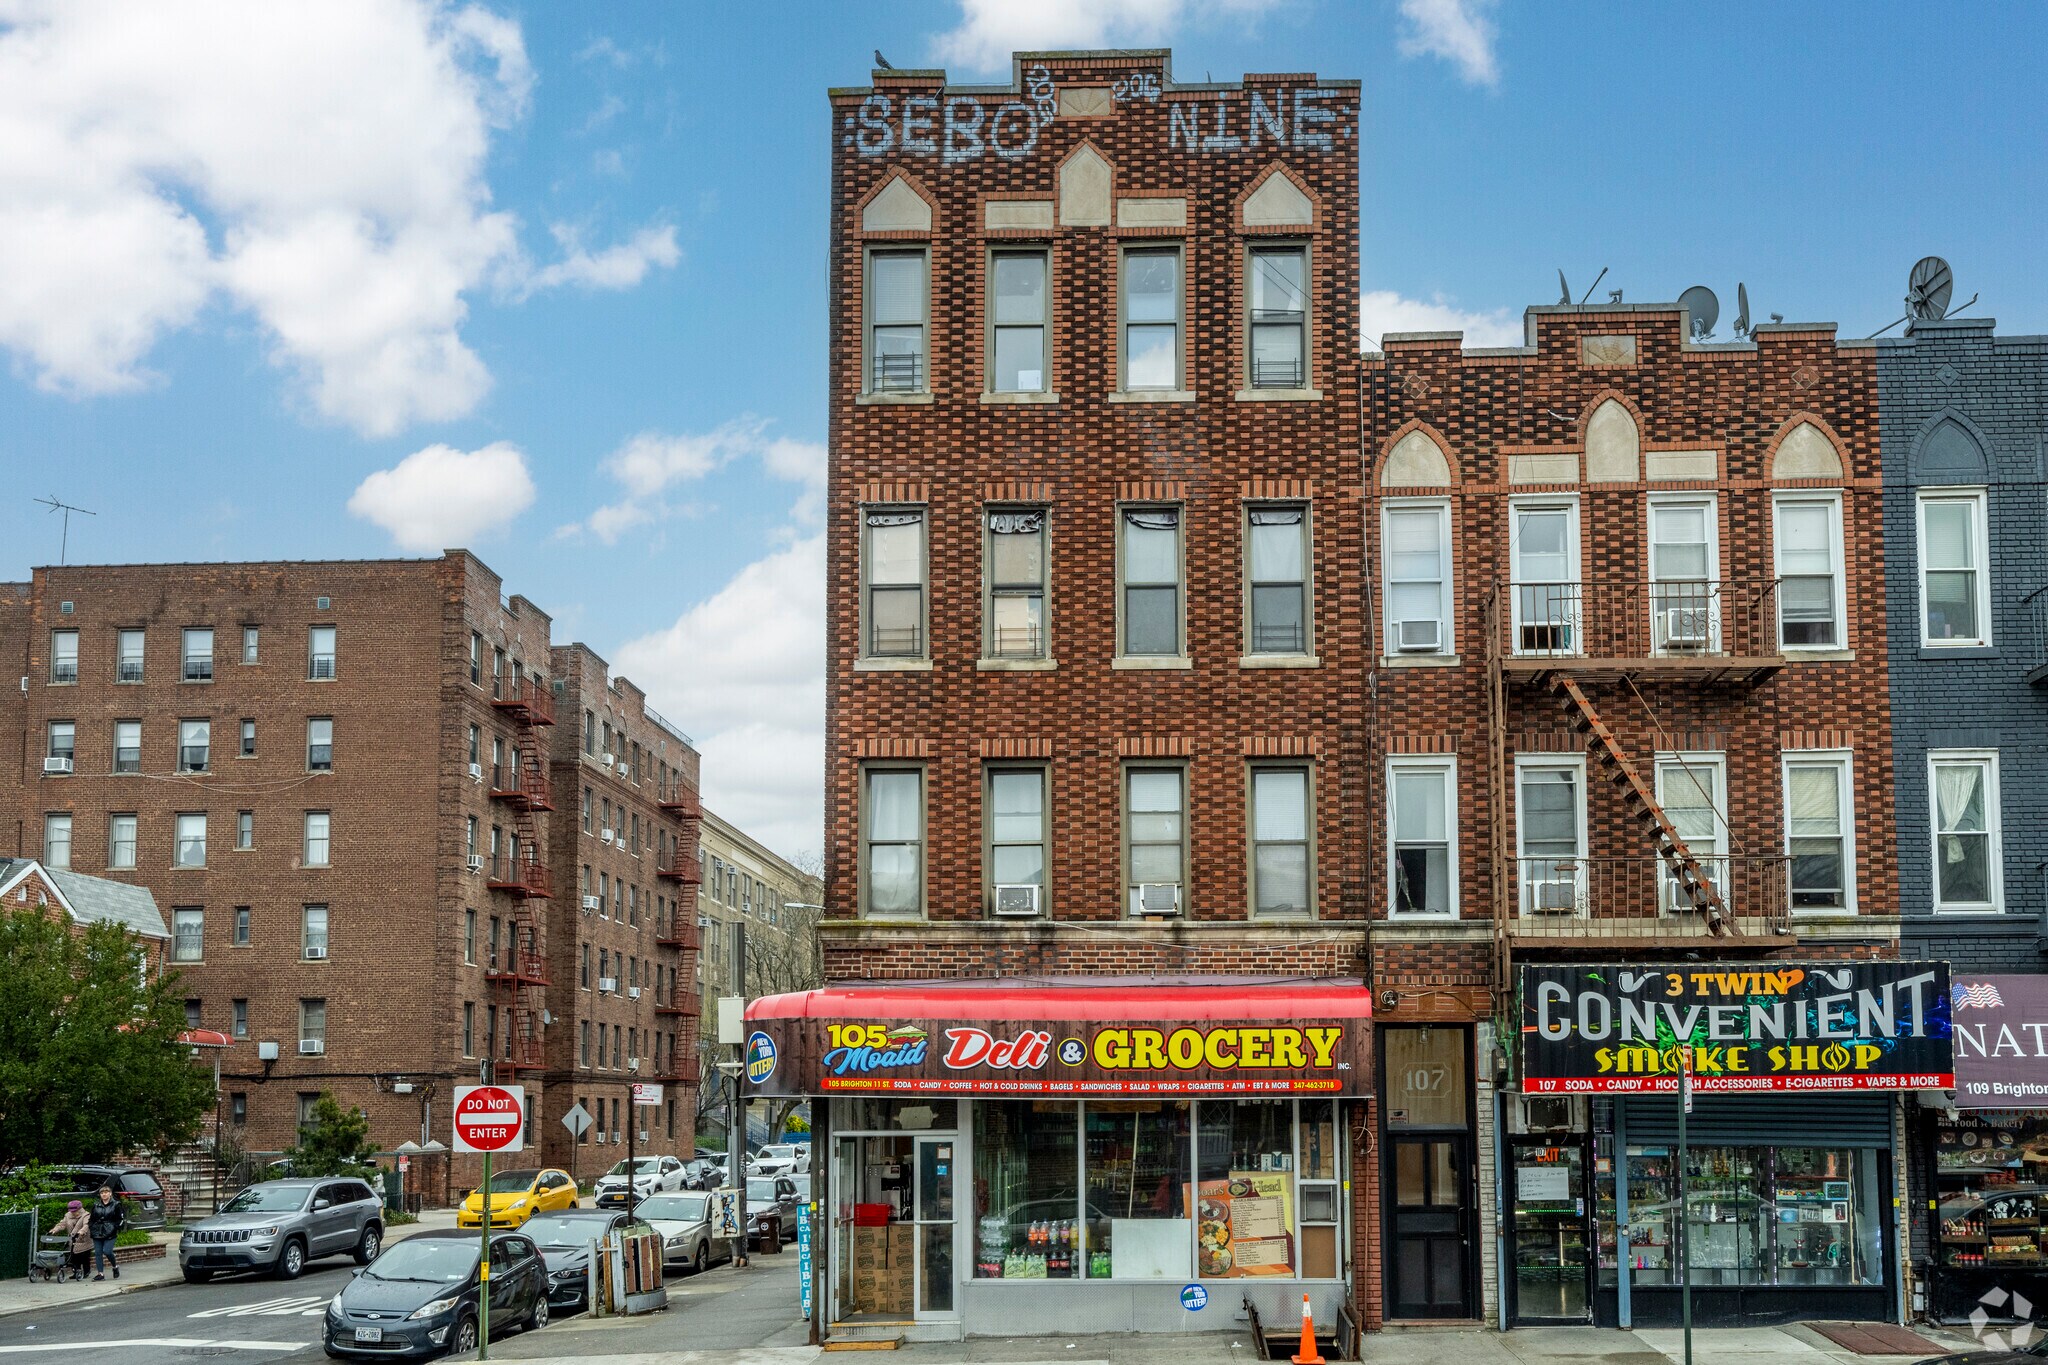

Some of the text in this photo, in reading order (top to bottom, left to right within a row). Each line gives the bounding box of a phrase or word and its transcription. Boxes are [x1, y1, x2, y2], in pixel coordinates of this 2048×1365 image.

[1665, 977, 1683, 997] 3
[1537, 972, 1936, 1040] CONVENIENT
[757, 1038, 769, 1047] NEW
[827, 1024, 888, 1048] 105
[758, 1046, 773, 1058] YORK
[943, 1027, 1053, 1070] Deli
[1063, 1041, 1082, 1063] &
[1093, 1027, 1343, 1070] GROCERY
[823, 1040, 929, 1076] Moaid
[1595, 1041, 1882, 1074] SMOKE SHOP
[841, 1080, 872, 1088] BRIGHTON
[894, 1081, 912, 1089] SODA
[949, 1082, 972, 1090] COFFEE
[979, 1082, 993, 1090] HOT
[1000, 1082, 1018, 1090] COLD
[1019, 1082, 1043, 1090] DRINKS
[1050, 1082, 1074, 1090] BAGELS
[1080, 1082, 1122, 1090] SANDWICHES
[1129, 1082, 1150, 1090] SALAD
[1157, 1082, 1180, 1090] WRAPS
[1187, 1082, 1225, 1090] CIGARETTES
[1231, 1082, 1245, 1090] ATM
[1293, 1081, 1335, 1089] 347-462-3718
[1406, 1069, 1445, 1091] 107
[1538, 1080, 1556, 1091] 107
[1565, 1080, 1594, 1090] SODA
[1606, 1079, 1643, 1090] CANDY
[1704, 1078, 1773, 1089] ACCESSORIES
[1785, 1077, 1854, 1088] E-CIGARETTES
[1865, 1076, 1897, 1087] VAPES
[1900, 1076, 1908, 1087] &
[1910, 1075, 1940, 1087] MORE
[1965, 1082, 1990, 1095] 109
[467, 1099, 510, 1110] DO NOT
[1954, 1118, 2025, 1130] Food Bakery
[469, 1128, 507, 1138] ENTER
[1198, 1179, 1282, 1197] oar's Head
